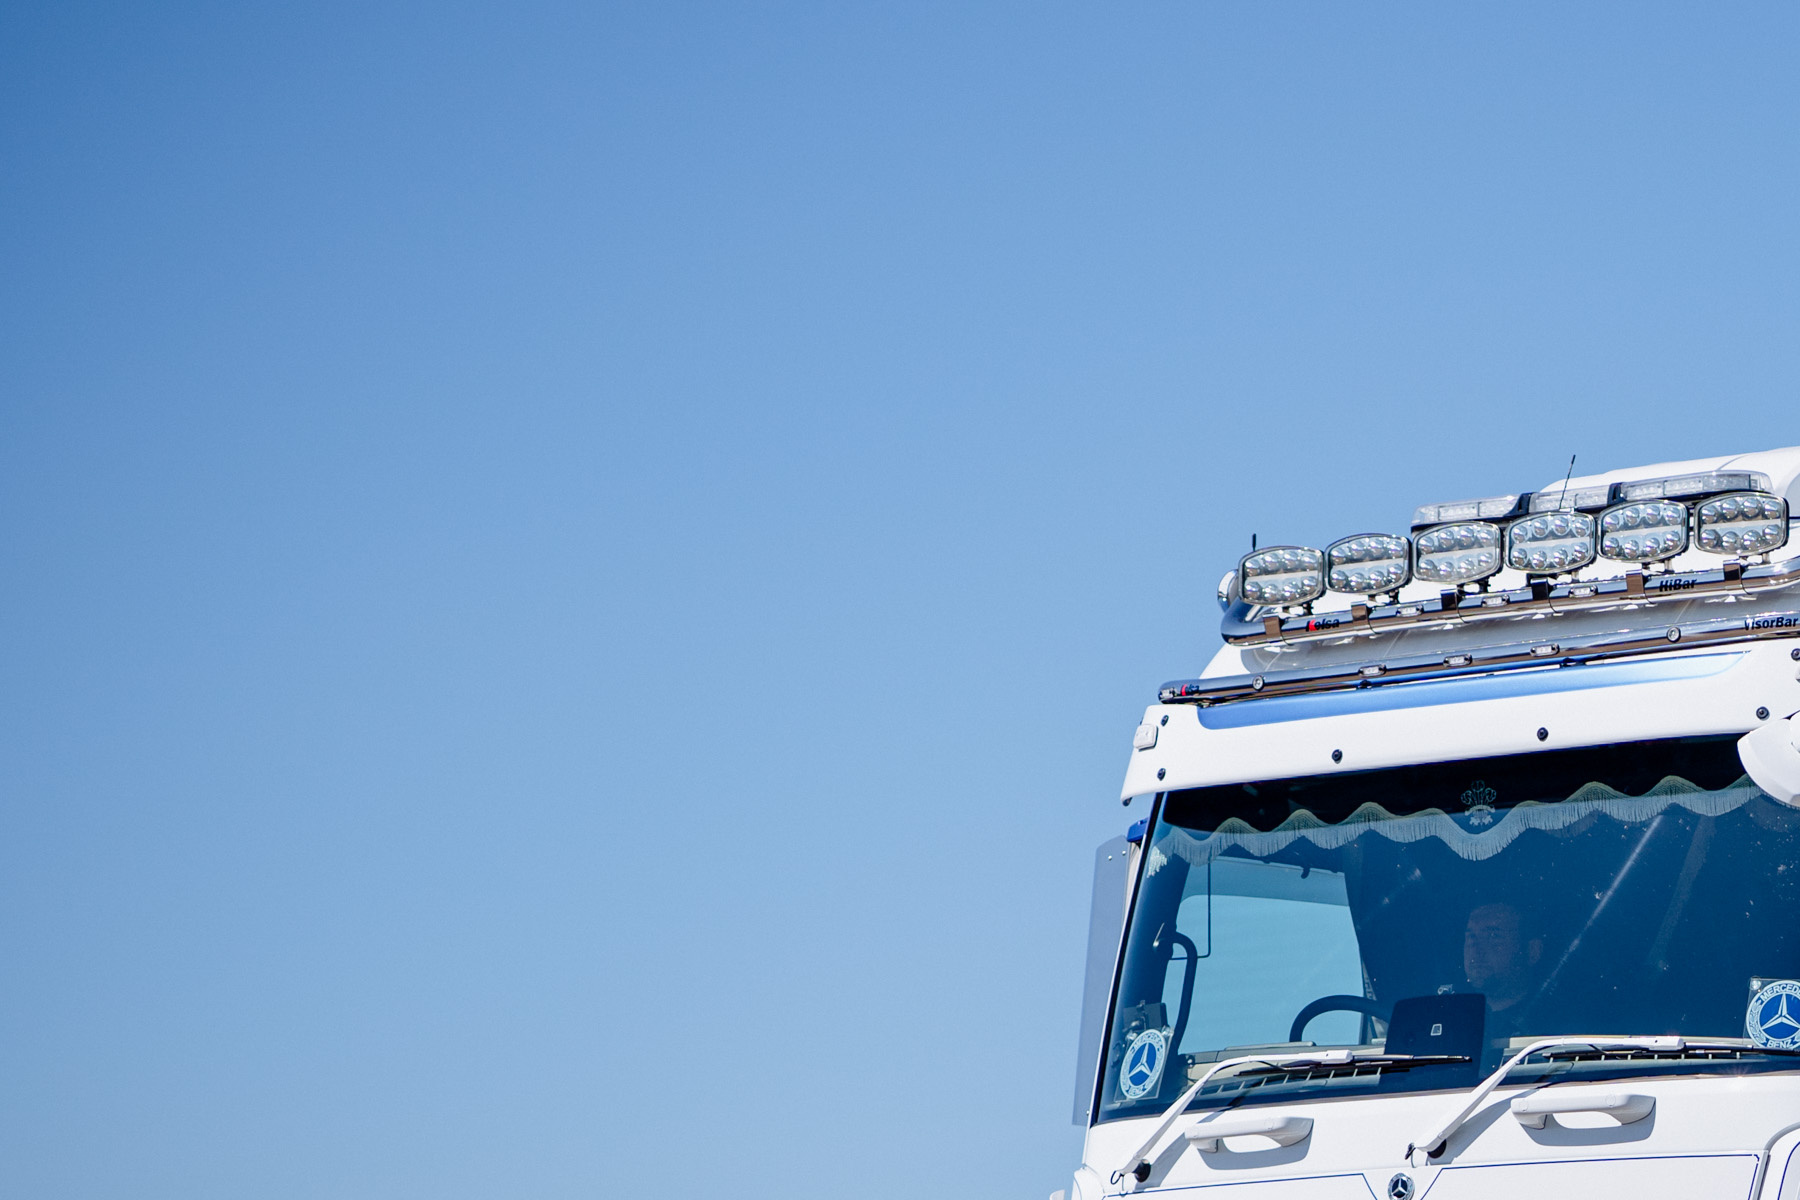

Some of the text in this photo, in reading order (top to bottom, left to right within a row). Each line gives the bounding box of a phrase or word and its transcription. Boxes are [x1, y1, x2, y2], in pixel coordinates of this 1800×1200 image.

[1659, 578, 1697, 592] HiBar
[1305, 618, 1340, 632] Kelsa
[1744, 616, 1799, 631] VisorBar
[1766, 1039, 1793, 1049] BENZ
